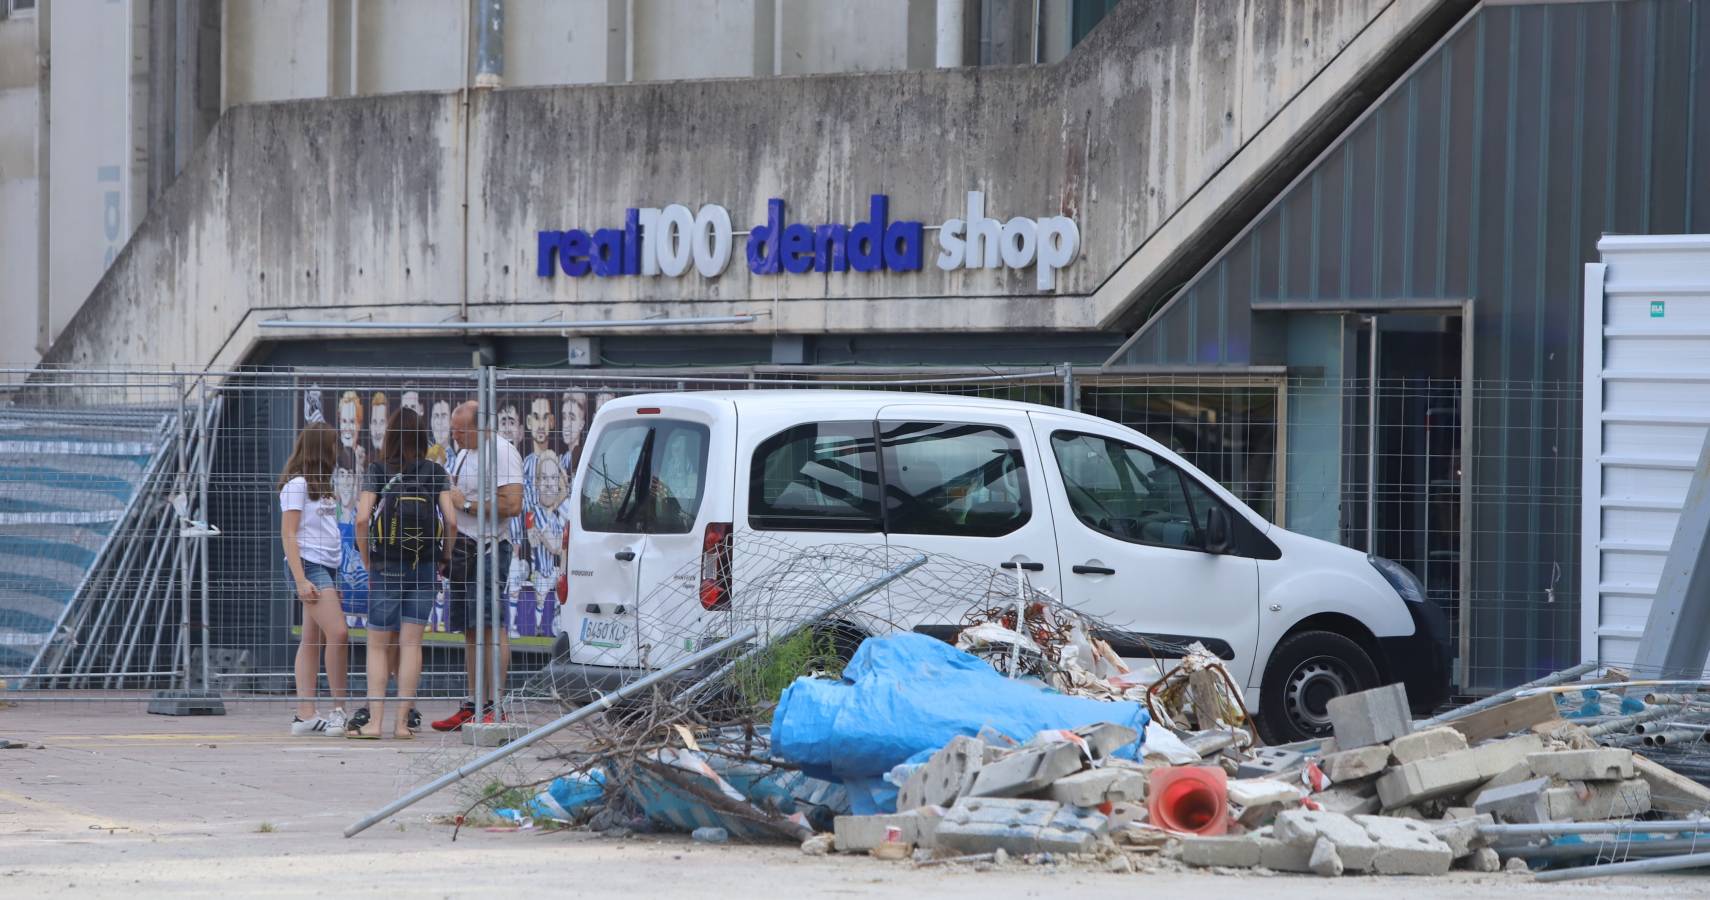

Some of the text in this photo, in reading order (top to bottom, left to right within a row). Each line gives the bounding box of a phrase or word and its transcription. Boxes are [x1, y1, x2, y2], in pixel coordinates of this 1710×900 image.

[746, 194, 923, 275] denda
[937, 190, 1081, 290] shop
[586, 621, 609, 639] 6450
